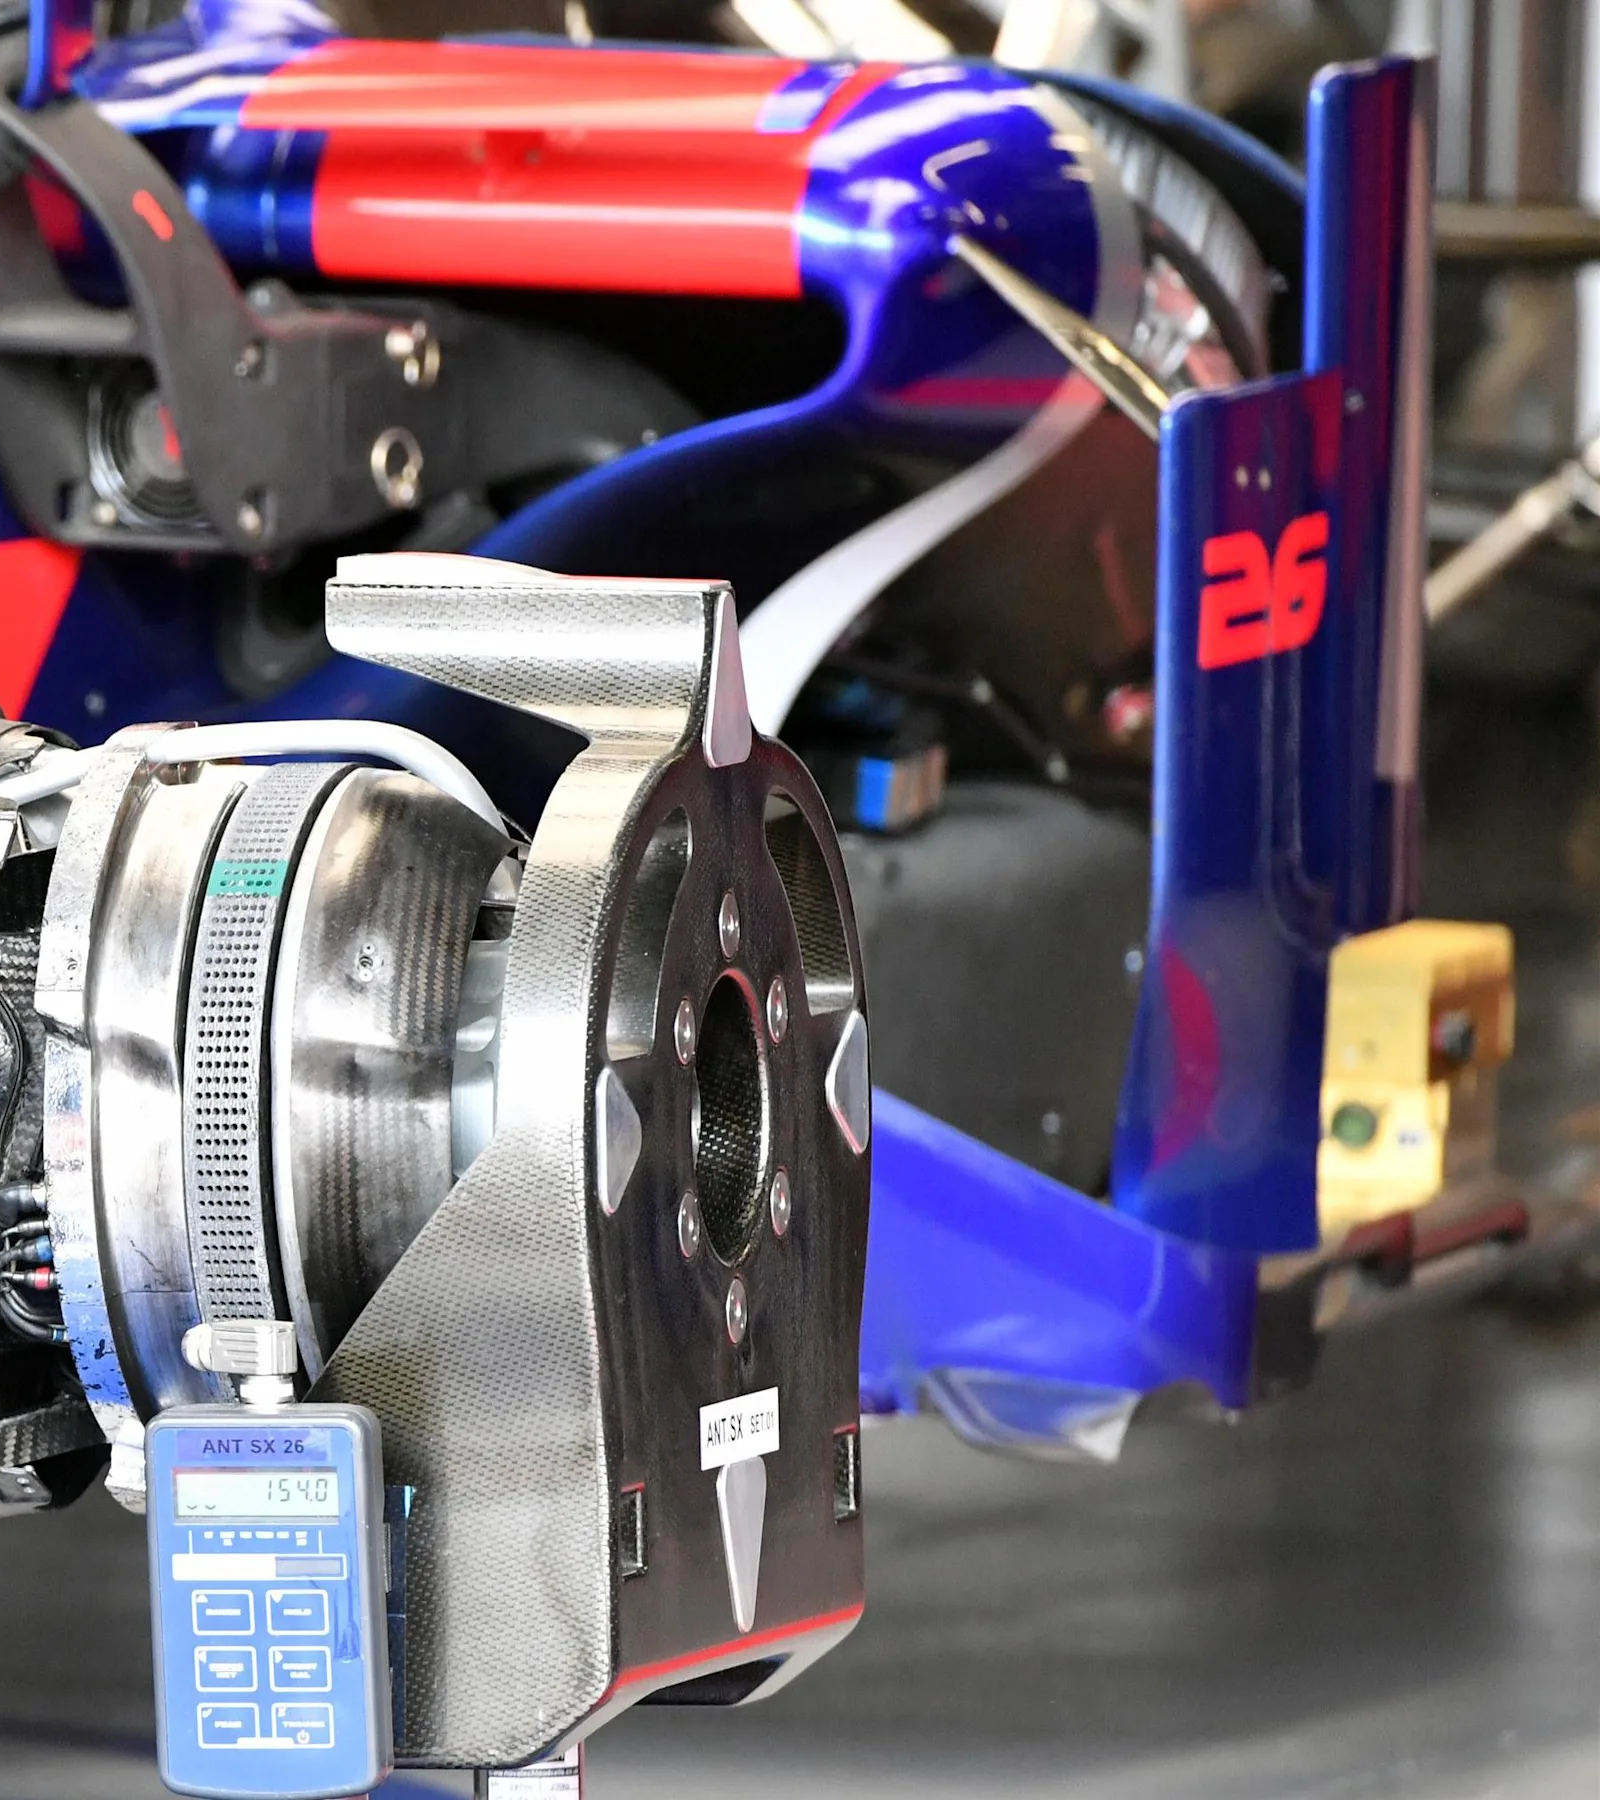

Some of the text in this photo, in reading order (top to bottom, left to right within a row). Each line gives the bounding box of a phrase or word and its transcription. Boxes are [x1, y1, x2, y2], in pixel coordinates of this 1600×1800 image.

[1197, 510, 1330, 671] 26
[202, 1439, 305, 1454] ANT SX 26
[267, 1478, 328, 1502] 154.0
